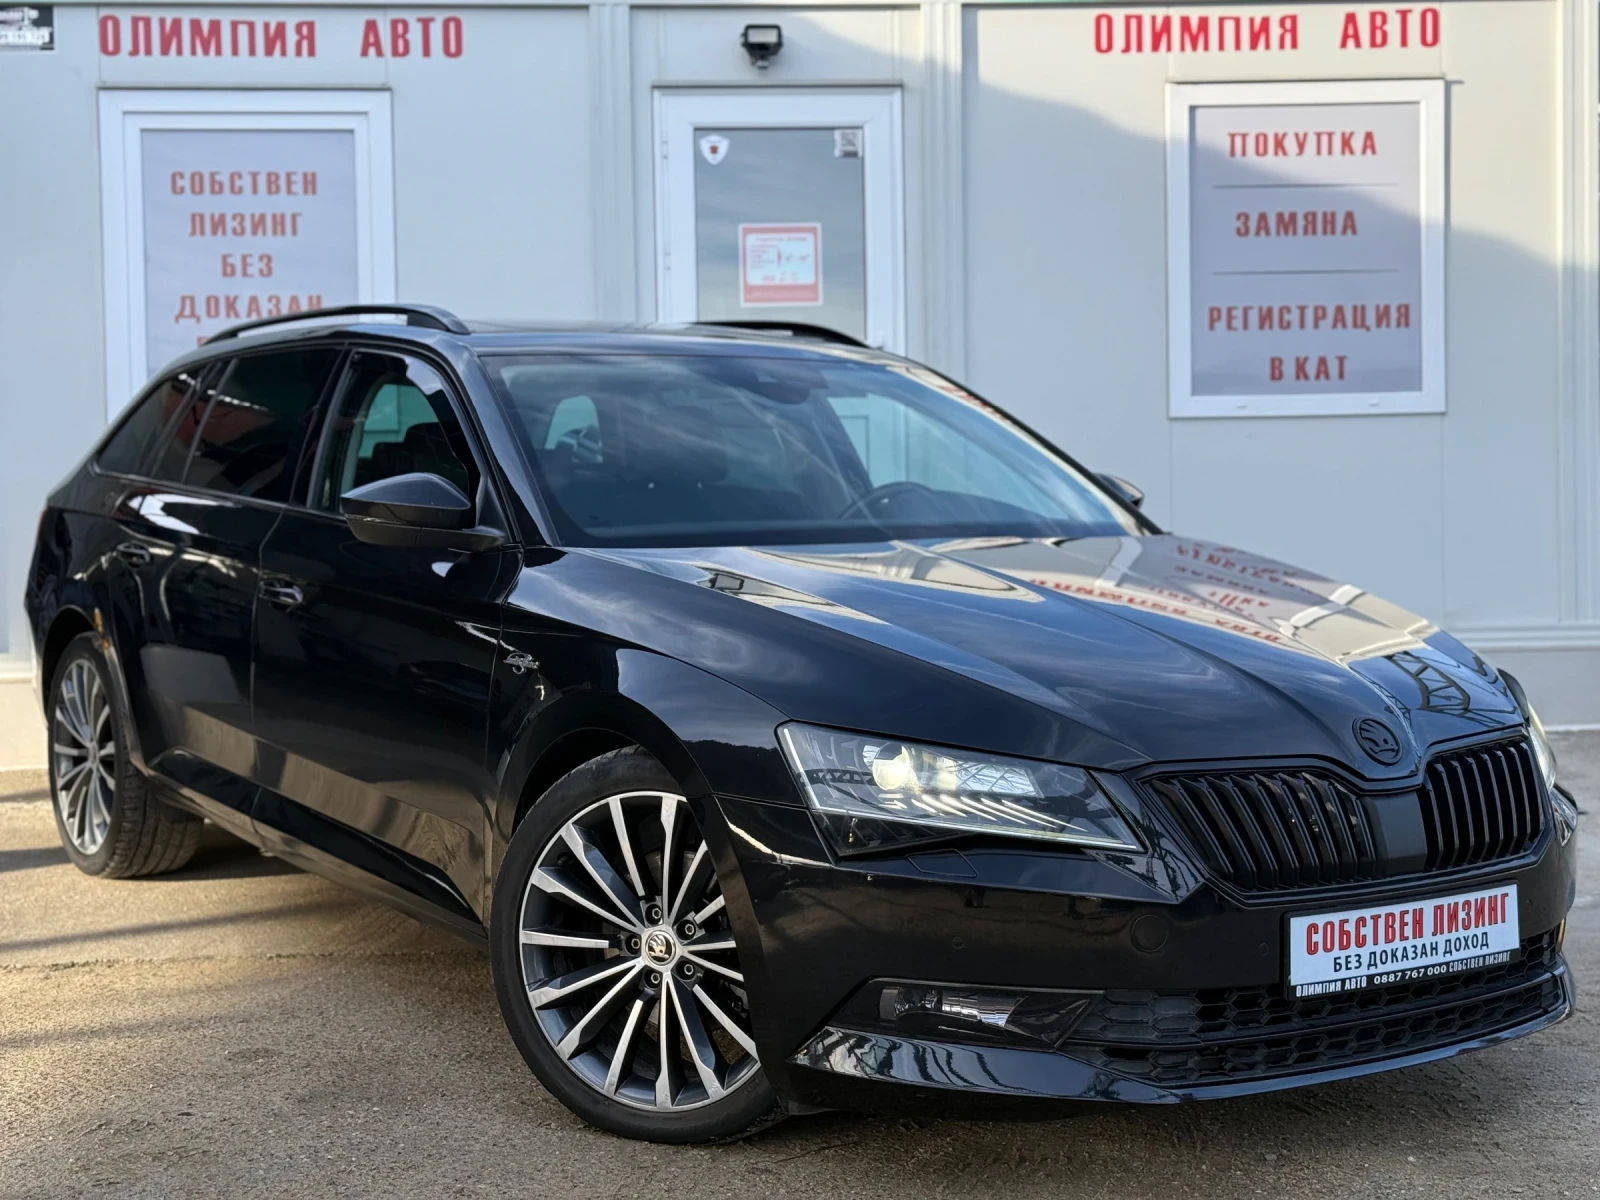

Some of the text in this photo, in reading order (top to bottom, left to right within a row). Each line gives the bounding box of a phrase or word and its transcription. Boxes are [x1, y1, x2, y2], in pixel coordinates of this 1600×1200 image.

[99, 15, 316, 57] ОЛИМПИЯ
[360, 16, 464, 58] АВТО
[1094, 8, 1440, 53] ОЛИМПИЯ АВТО
[1228, 131, 1377, 157] ПОКУПКА
[170, 171, 317, 195] СОБСТВЕН
[189, 212, 302, 237] ЛИЗИНГ
[1235, 211, 1358, 237] ЗАМЯНА
[221, 253, 273, 278] БЕЗ
[1208, 304, 1411, 332] РЕГИСТРАЦИЯ
[1270, 355, 1348, 381] В КАТ
[1306, 893, 1509, 955] СОБСТВЕН ЛИЗИНГ
[1333, 932, 1489, 973] БЕЗ ДОКАЗАН ДОХОД
[1296, 951, 1511, 997] ОЛИМПИЯ АВТО 0887 767 000 СОБСТВЕН ЛИЗИНГ
